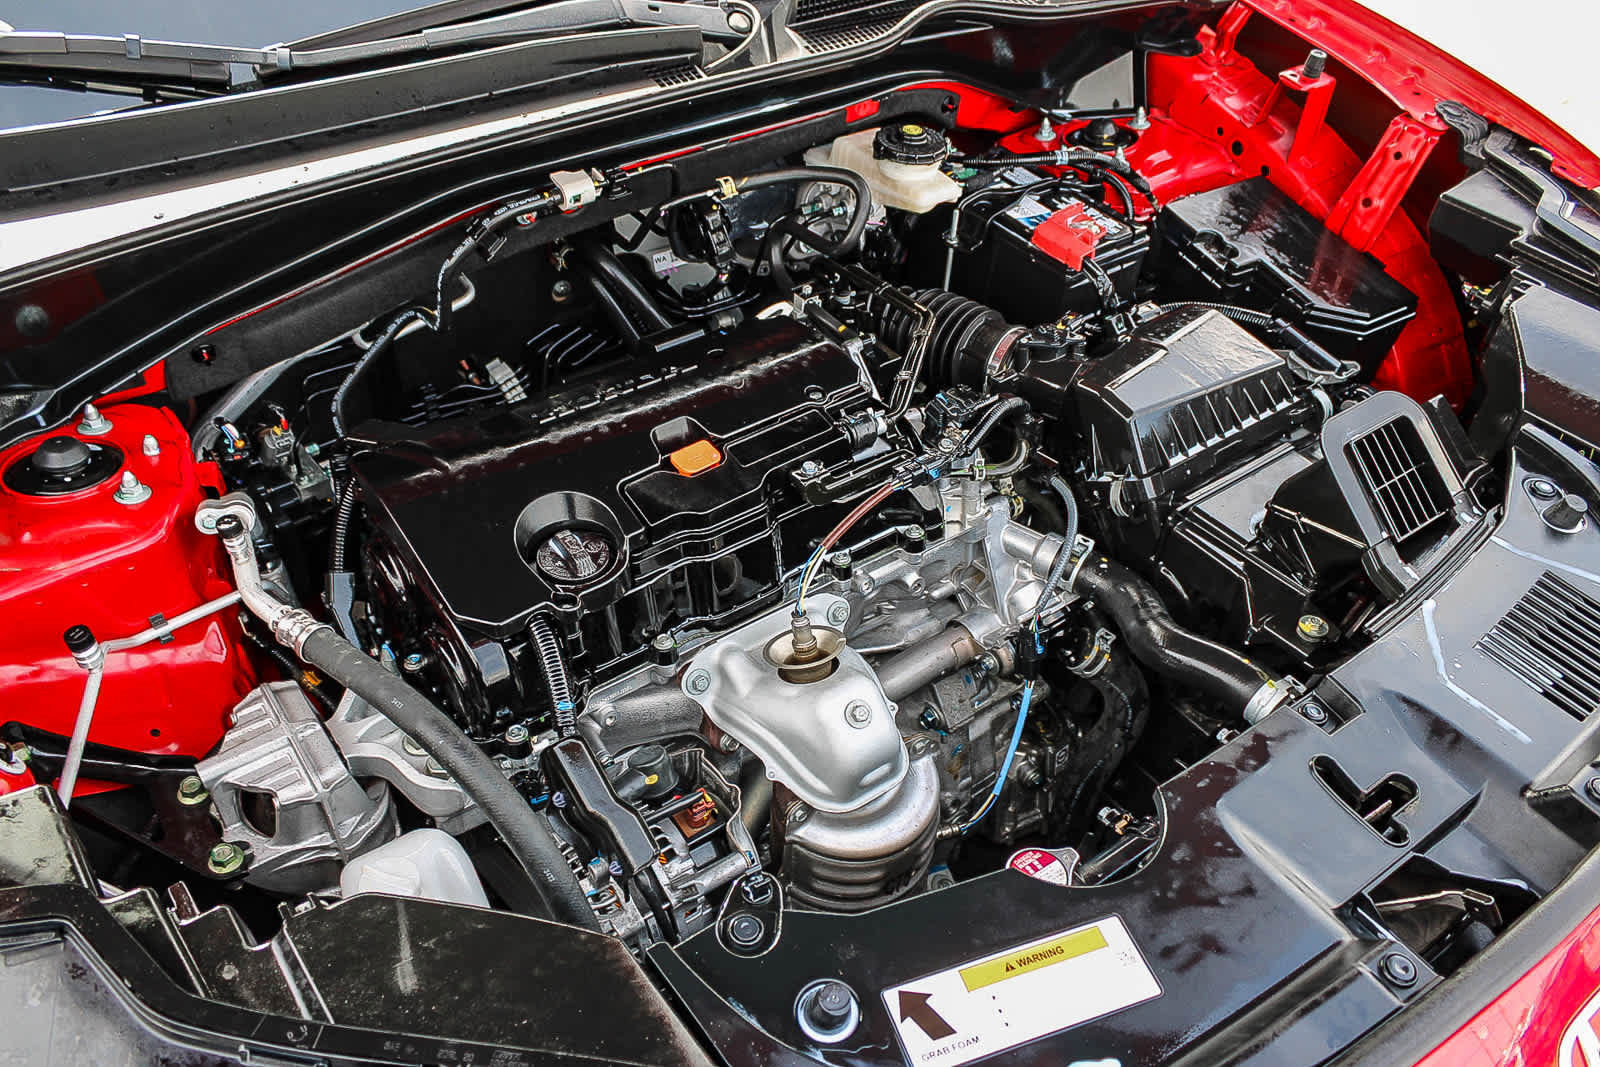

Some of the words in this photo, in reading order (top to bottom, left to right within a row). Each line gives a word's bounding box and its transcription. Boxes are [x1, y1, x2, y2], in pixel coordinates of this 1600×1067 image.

[1015, 945, 1065, 968] WARNING
[921, 1047, 951, 1061] GRAB
[952, 1035, 980, 1050] FOAM
